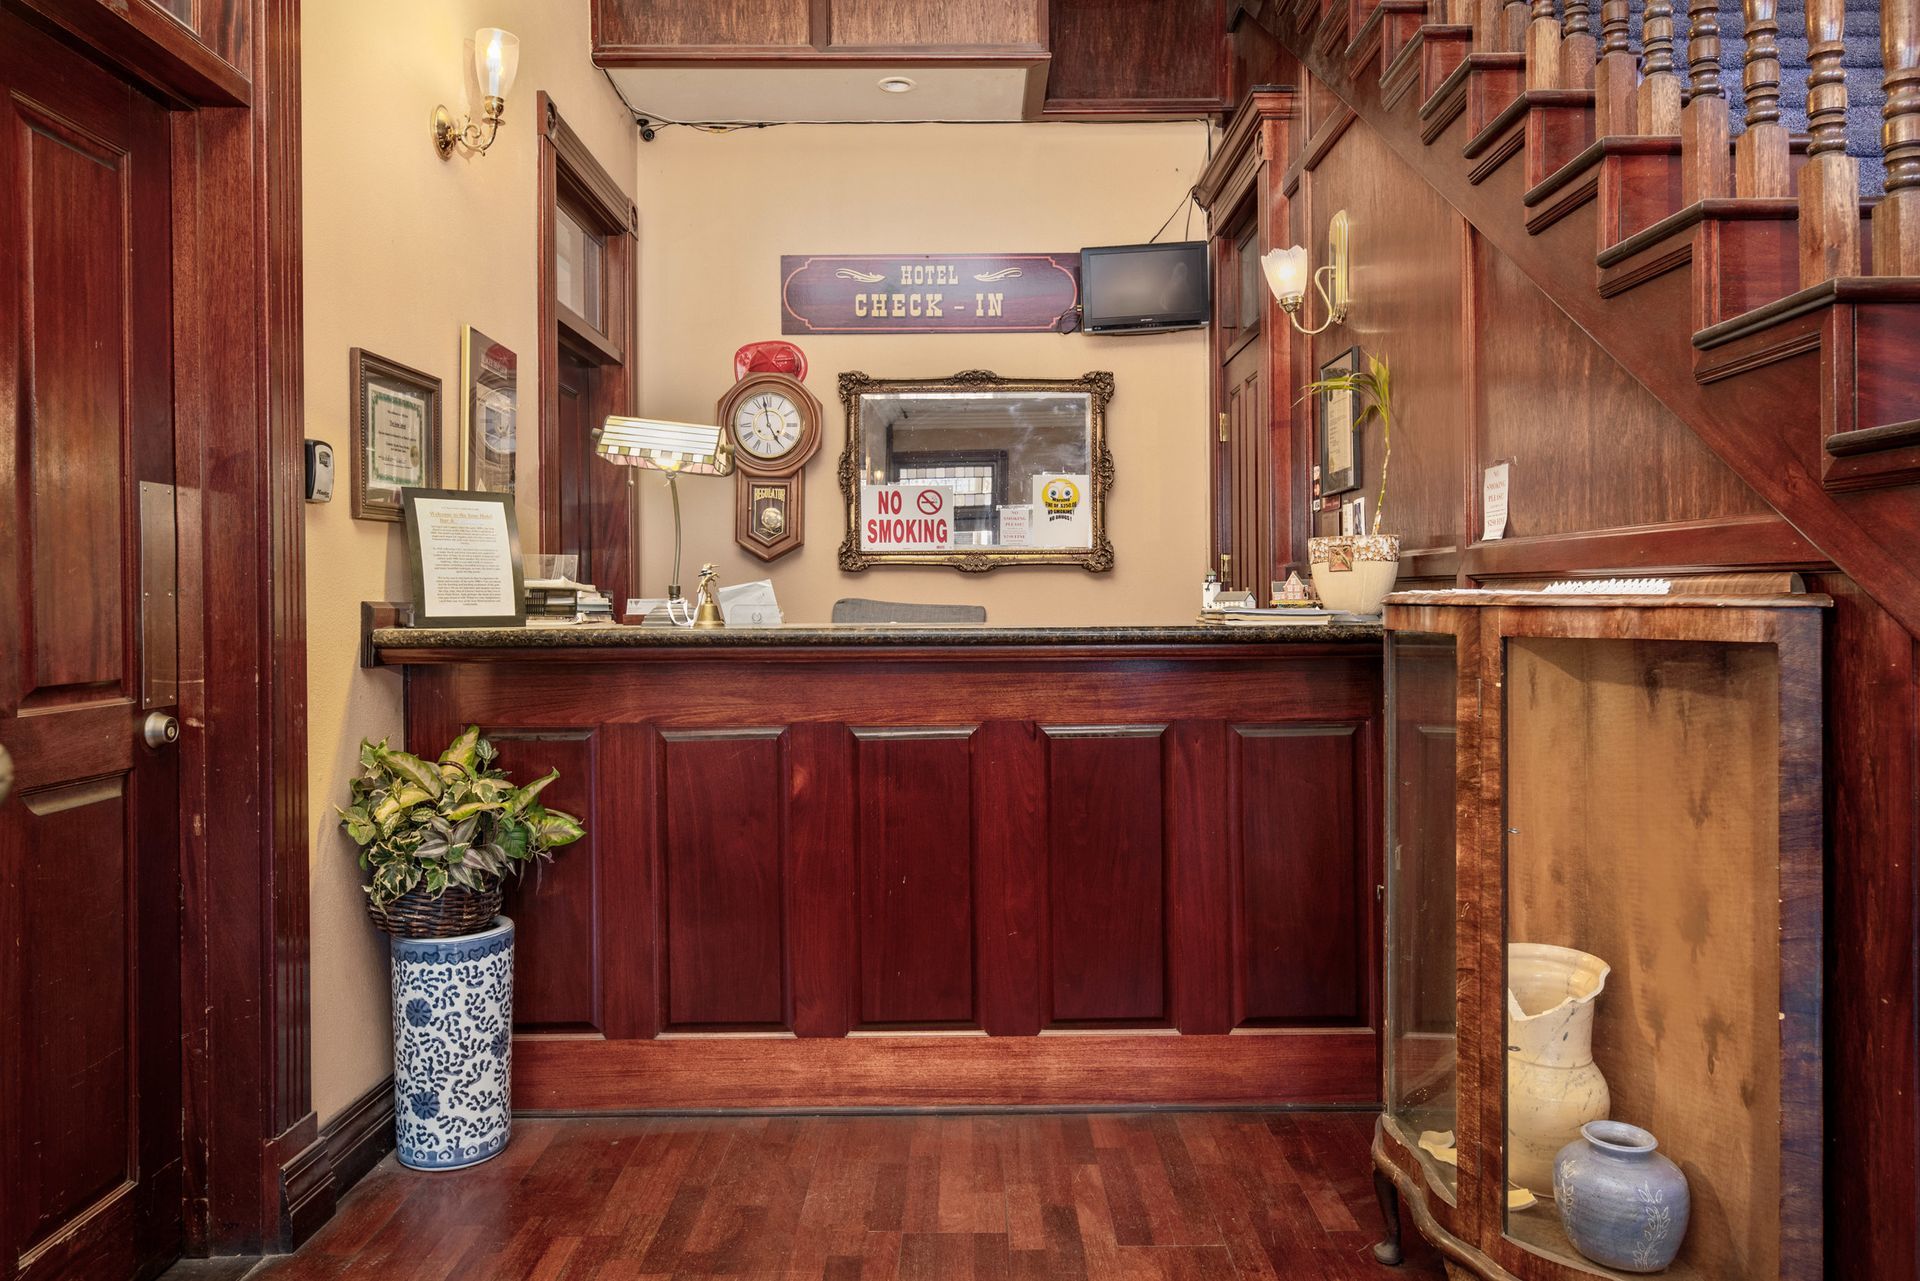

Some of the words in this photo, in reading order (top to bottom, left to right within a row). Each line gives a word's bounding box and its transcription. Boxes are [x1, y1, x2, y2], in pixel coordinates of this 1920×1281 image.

[901, 265, 959, 285] HOTEL
[855, 293, 943, 317] CHECK
[975, 292, 1004, 317] IN
[878, 490, 902, 515] NO
[867, 518, 948, 544] SMOKING
